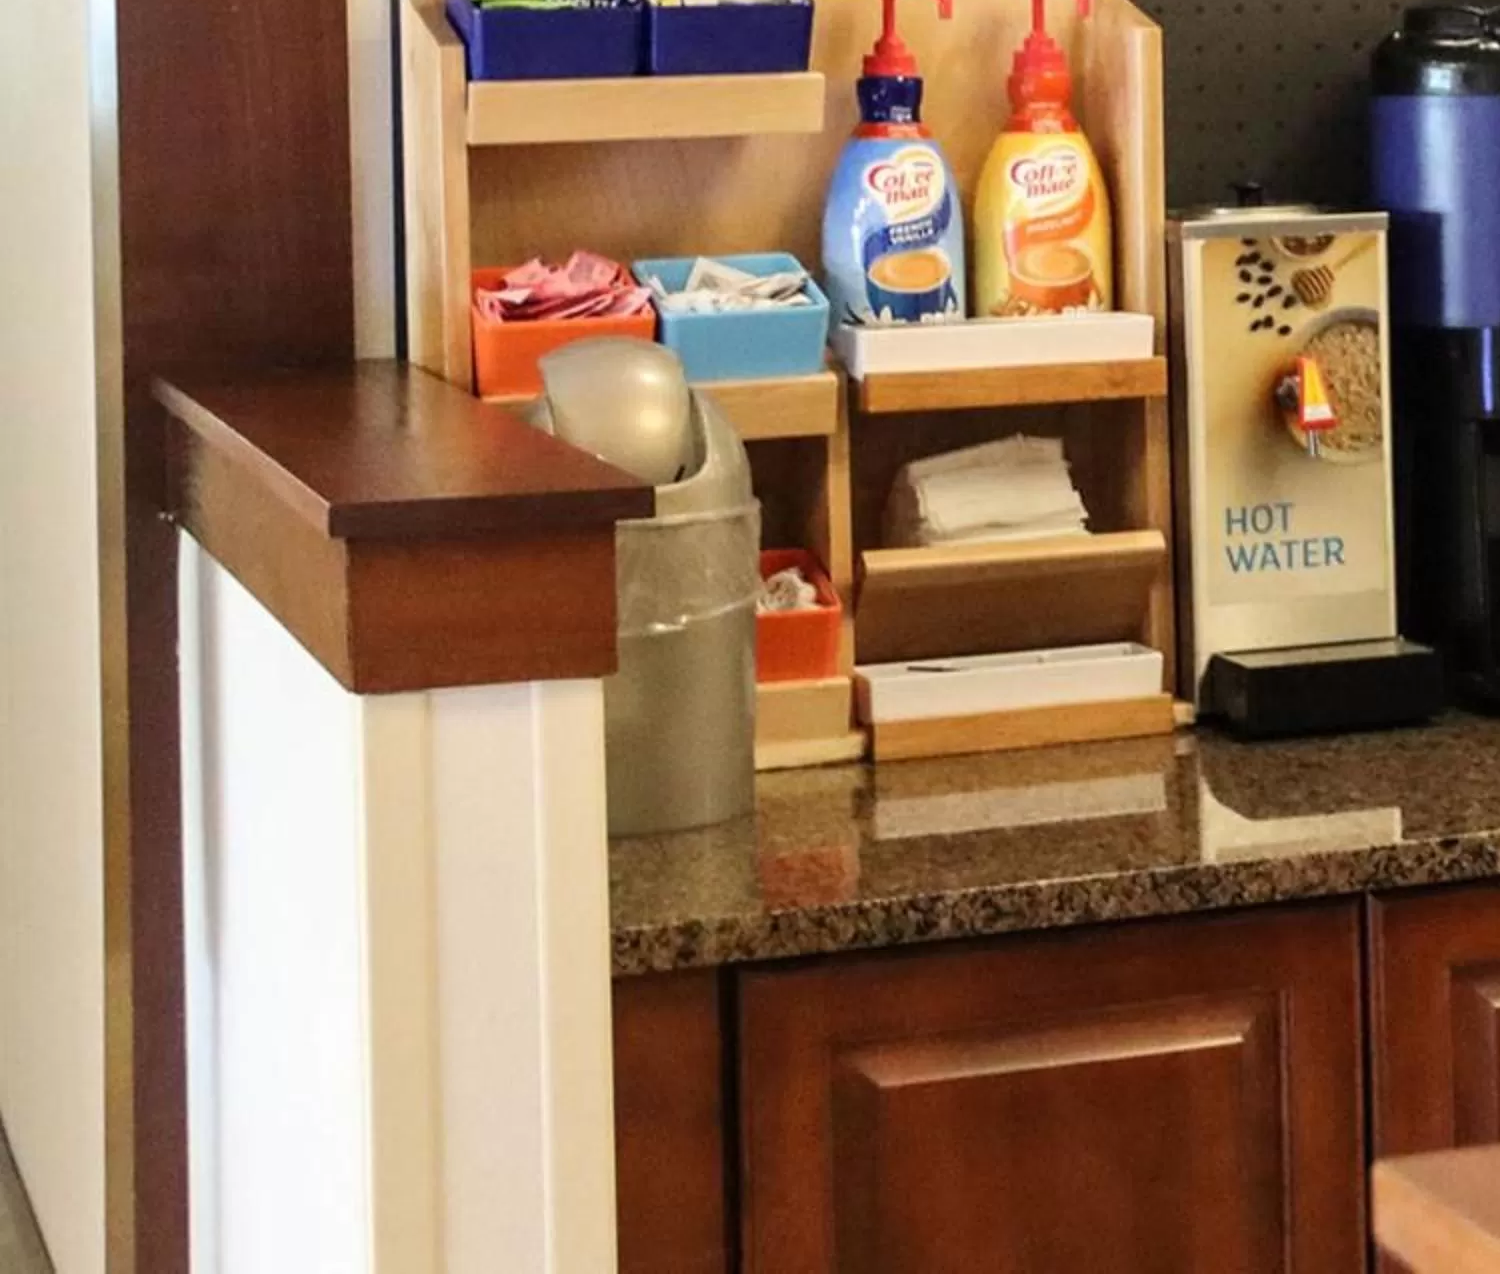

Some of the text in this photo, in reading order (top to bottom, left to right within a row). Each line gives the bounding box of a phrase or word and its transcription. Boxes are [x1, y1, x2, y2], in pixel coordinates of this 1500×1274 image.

[868, 163, 934, 193] Cofee
[1226, 501, 1294, 536] HOT
[1226, 536, 1345, 573] WATER
